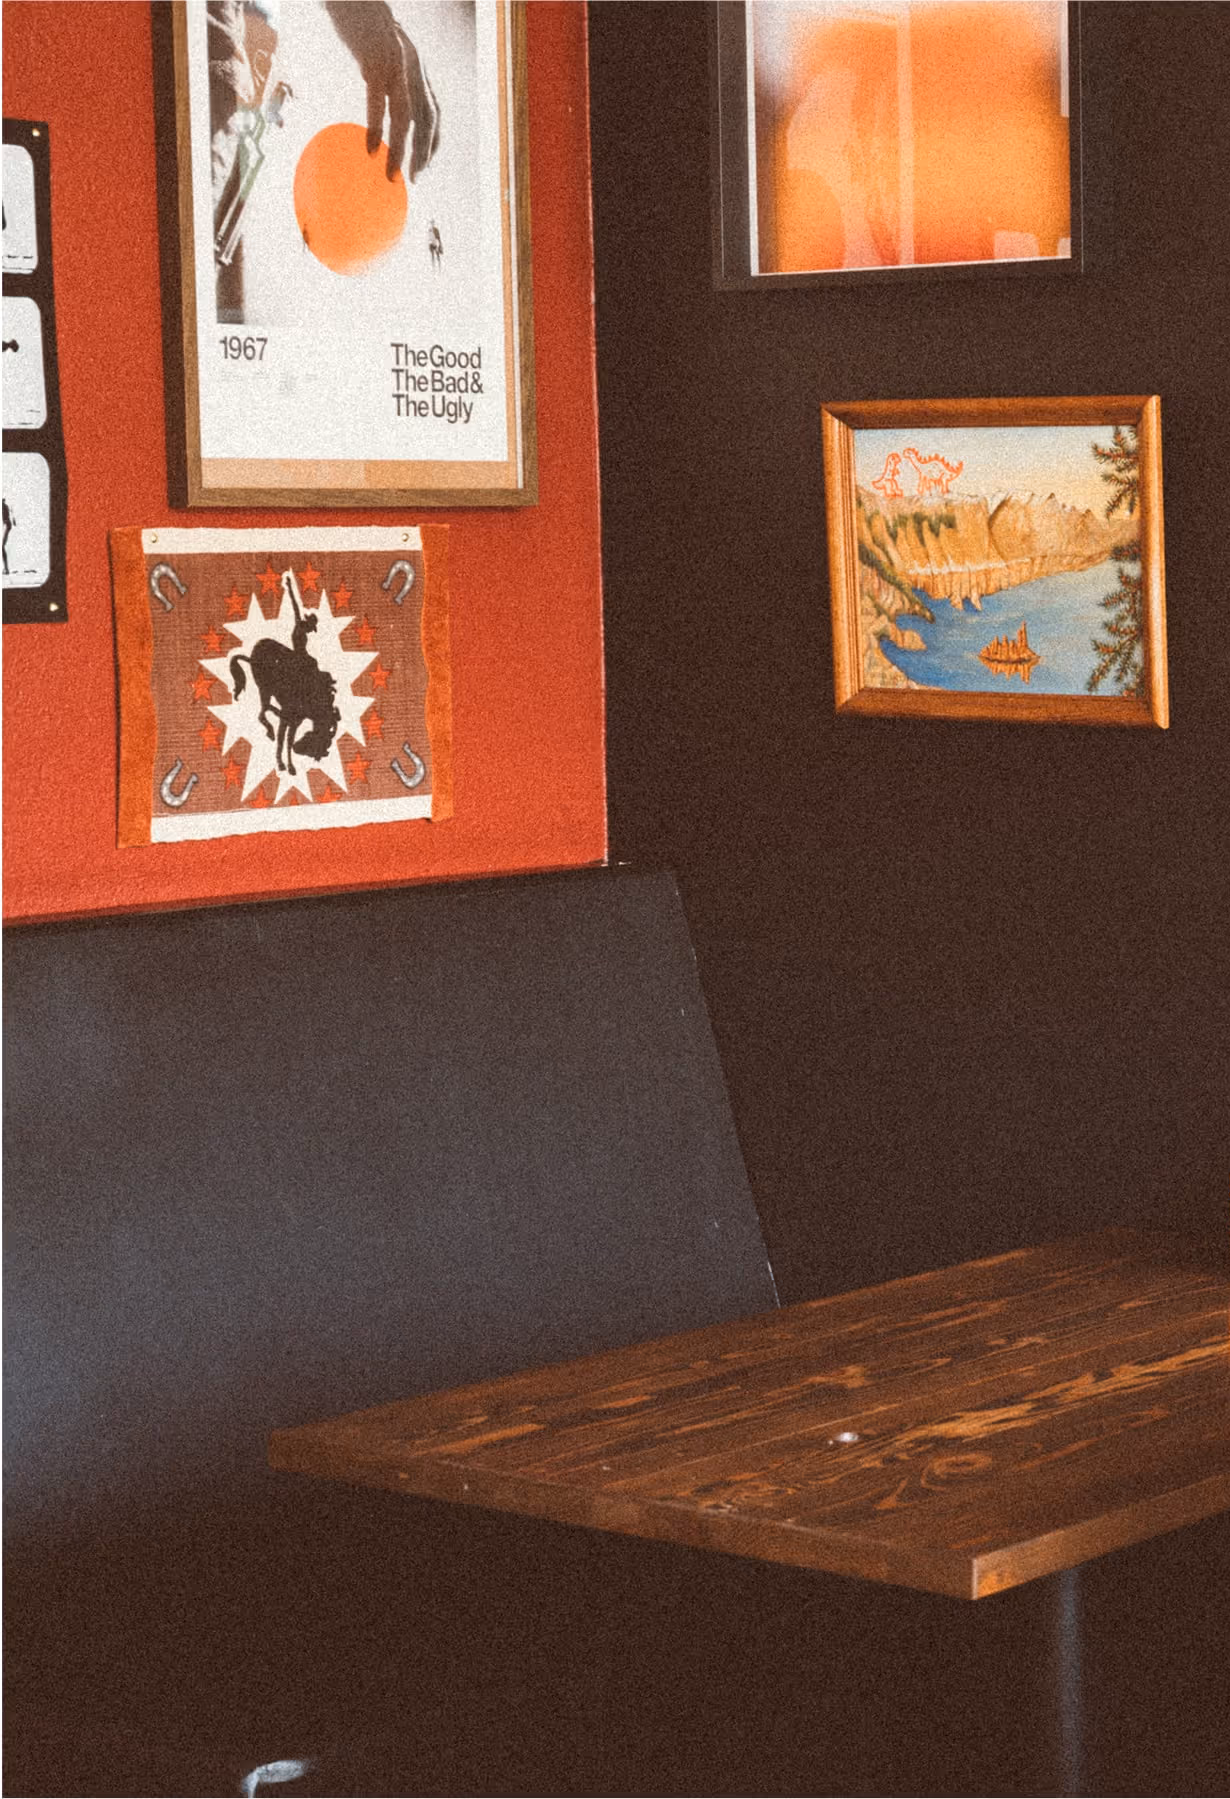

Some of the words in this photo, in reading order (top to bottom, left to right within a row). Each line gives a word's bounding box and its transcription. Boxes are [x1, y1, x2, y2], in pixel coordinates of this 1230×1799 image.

[219, 336, 268, 361] 1967
[390, 342, 428, 368] The
[429, 344, 482, 370] Good
[391, 368, 429, 393] The
[431, 370, 469, 394] Bad
[392, 393, 430, 418] The
[431, 394, 474, 424] Ugly
